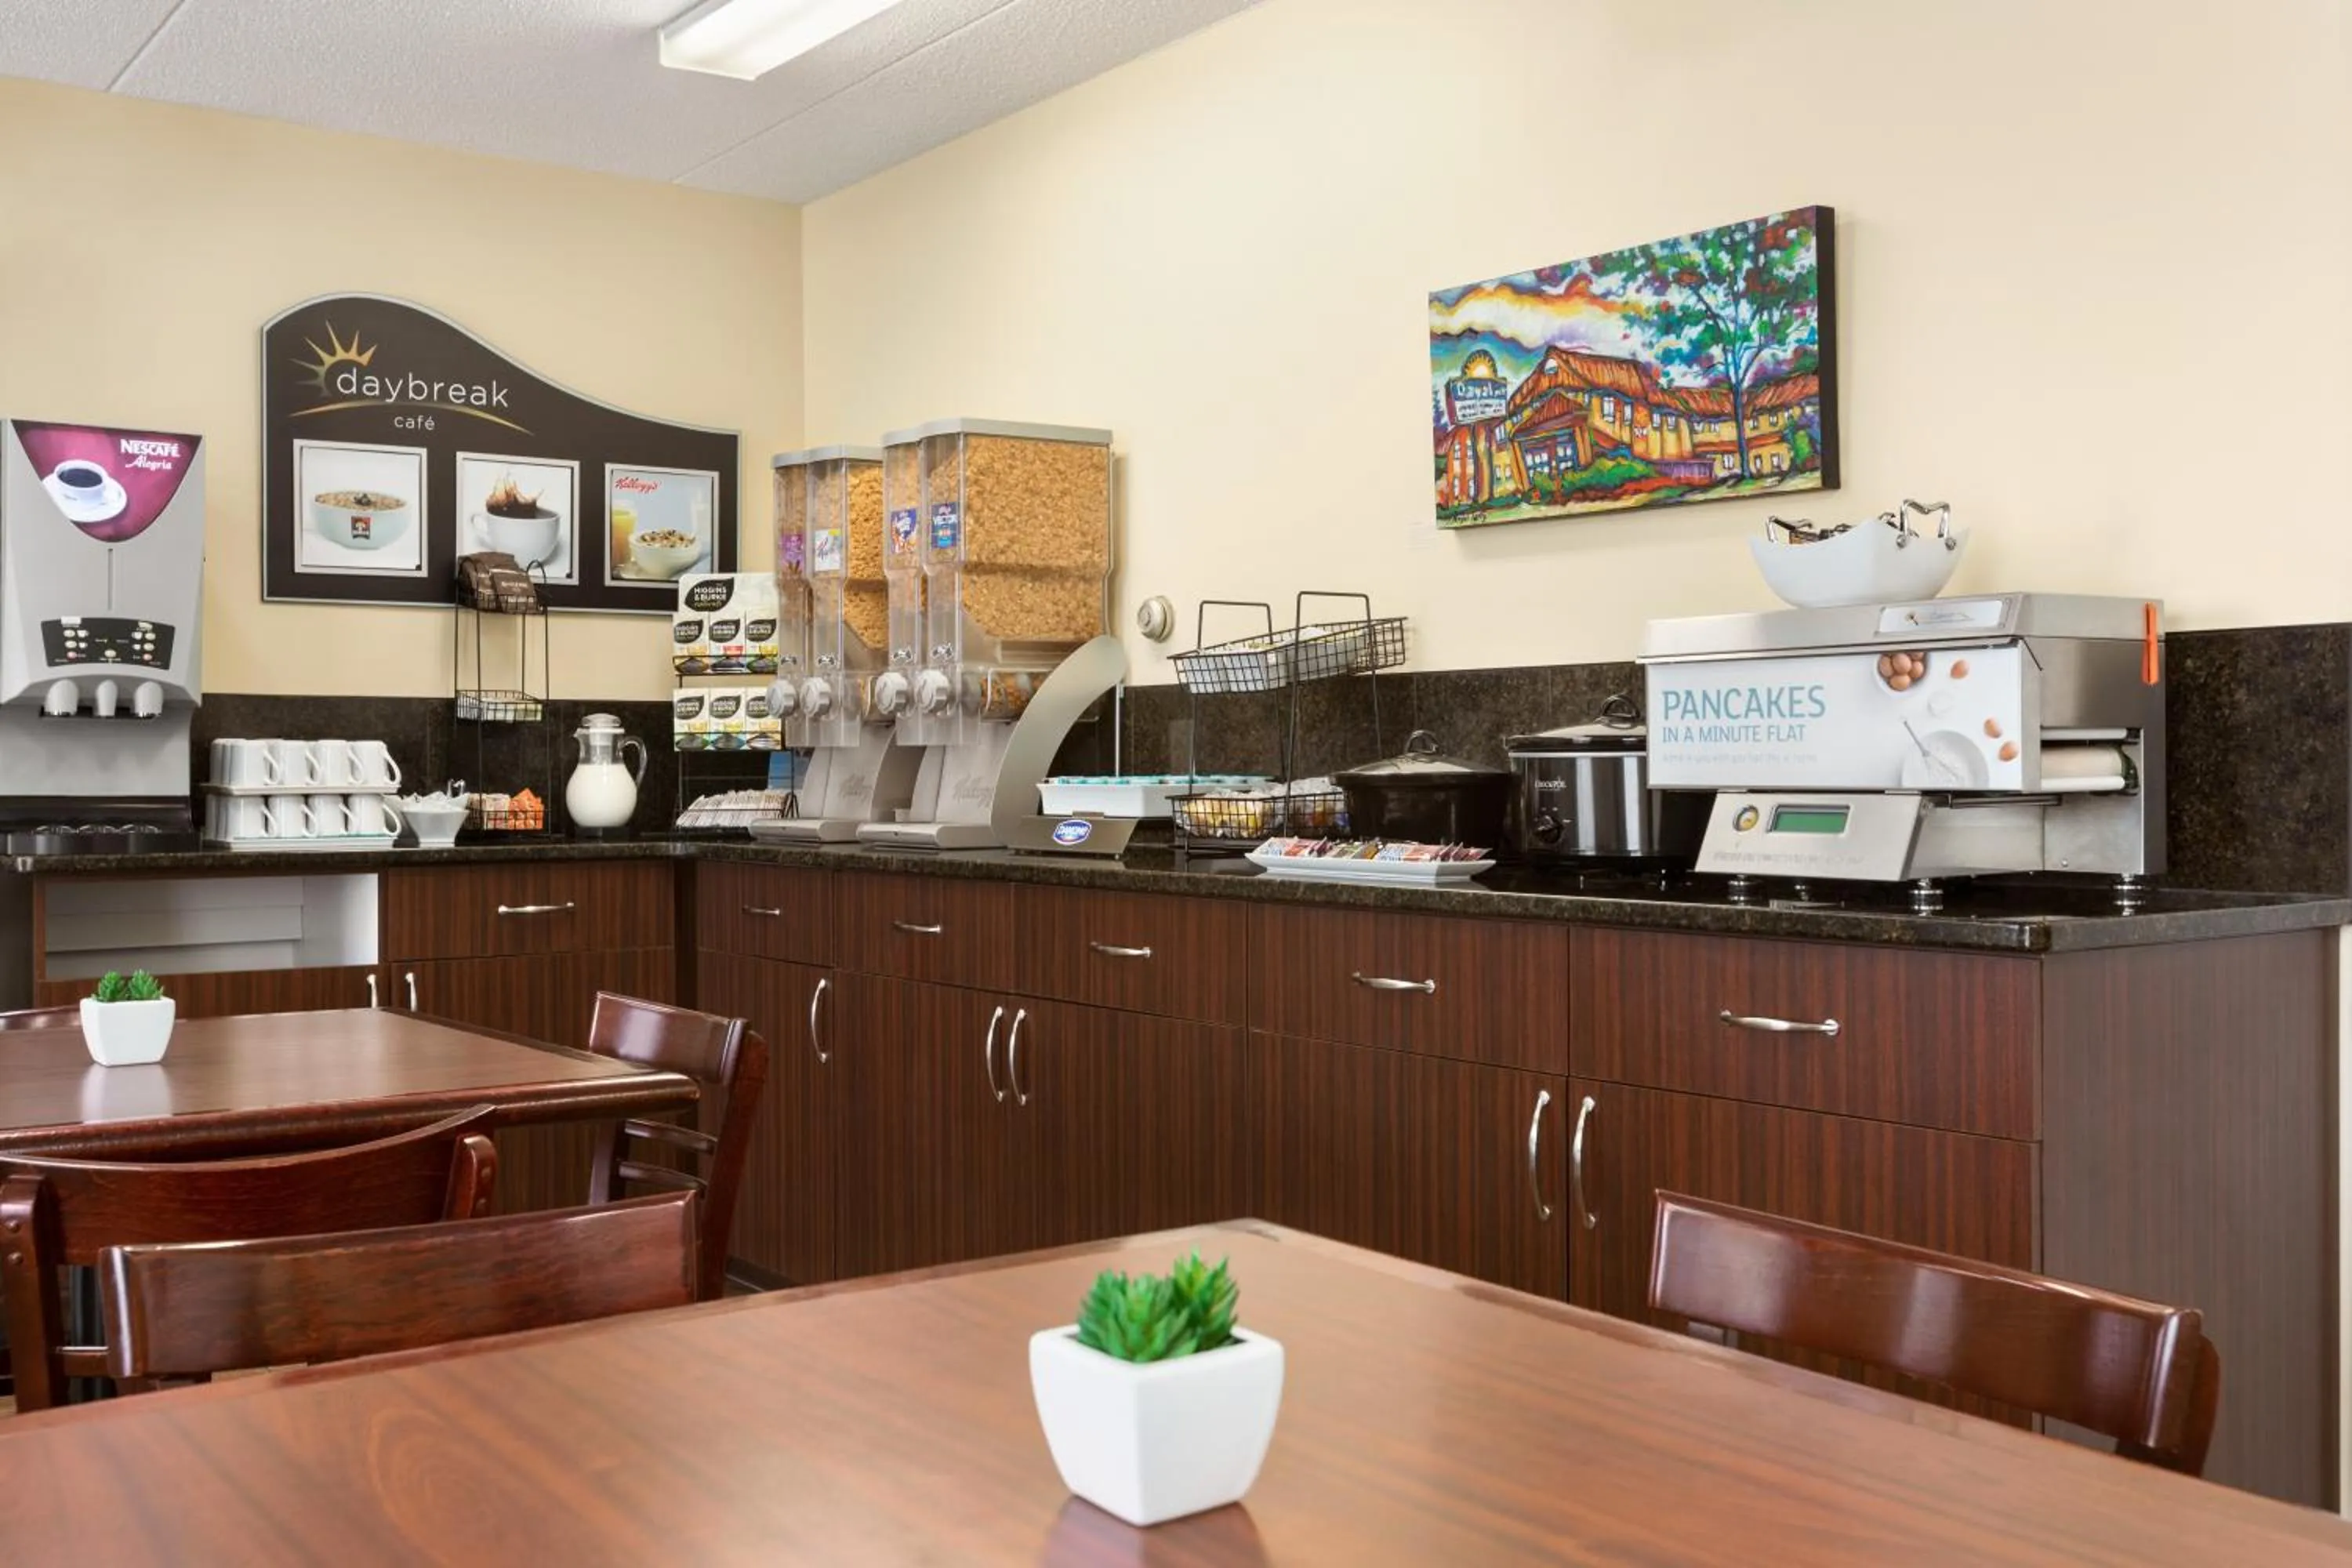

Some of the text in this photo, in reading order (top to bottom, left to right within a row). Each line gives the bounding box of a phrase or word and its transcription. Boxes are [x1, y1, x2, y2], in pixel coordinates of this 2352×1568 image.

[336, 367, 509, 408] daybreak
[394, 415, 436, 431] café
[1662, 685, 1826, 720] PANCAKES
[1662, 724, 1806, 743] IN A MINUTE FLAT
